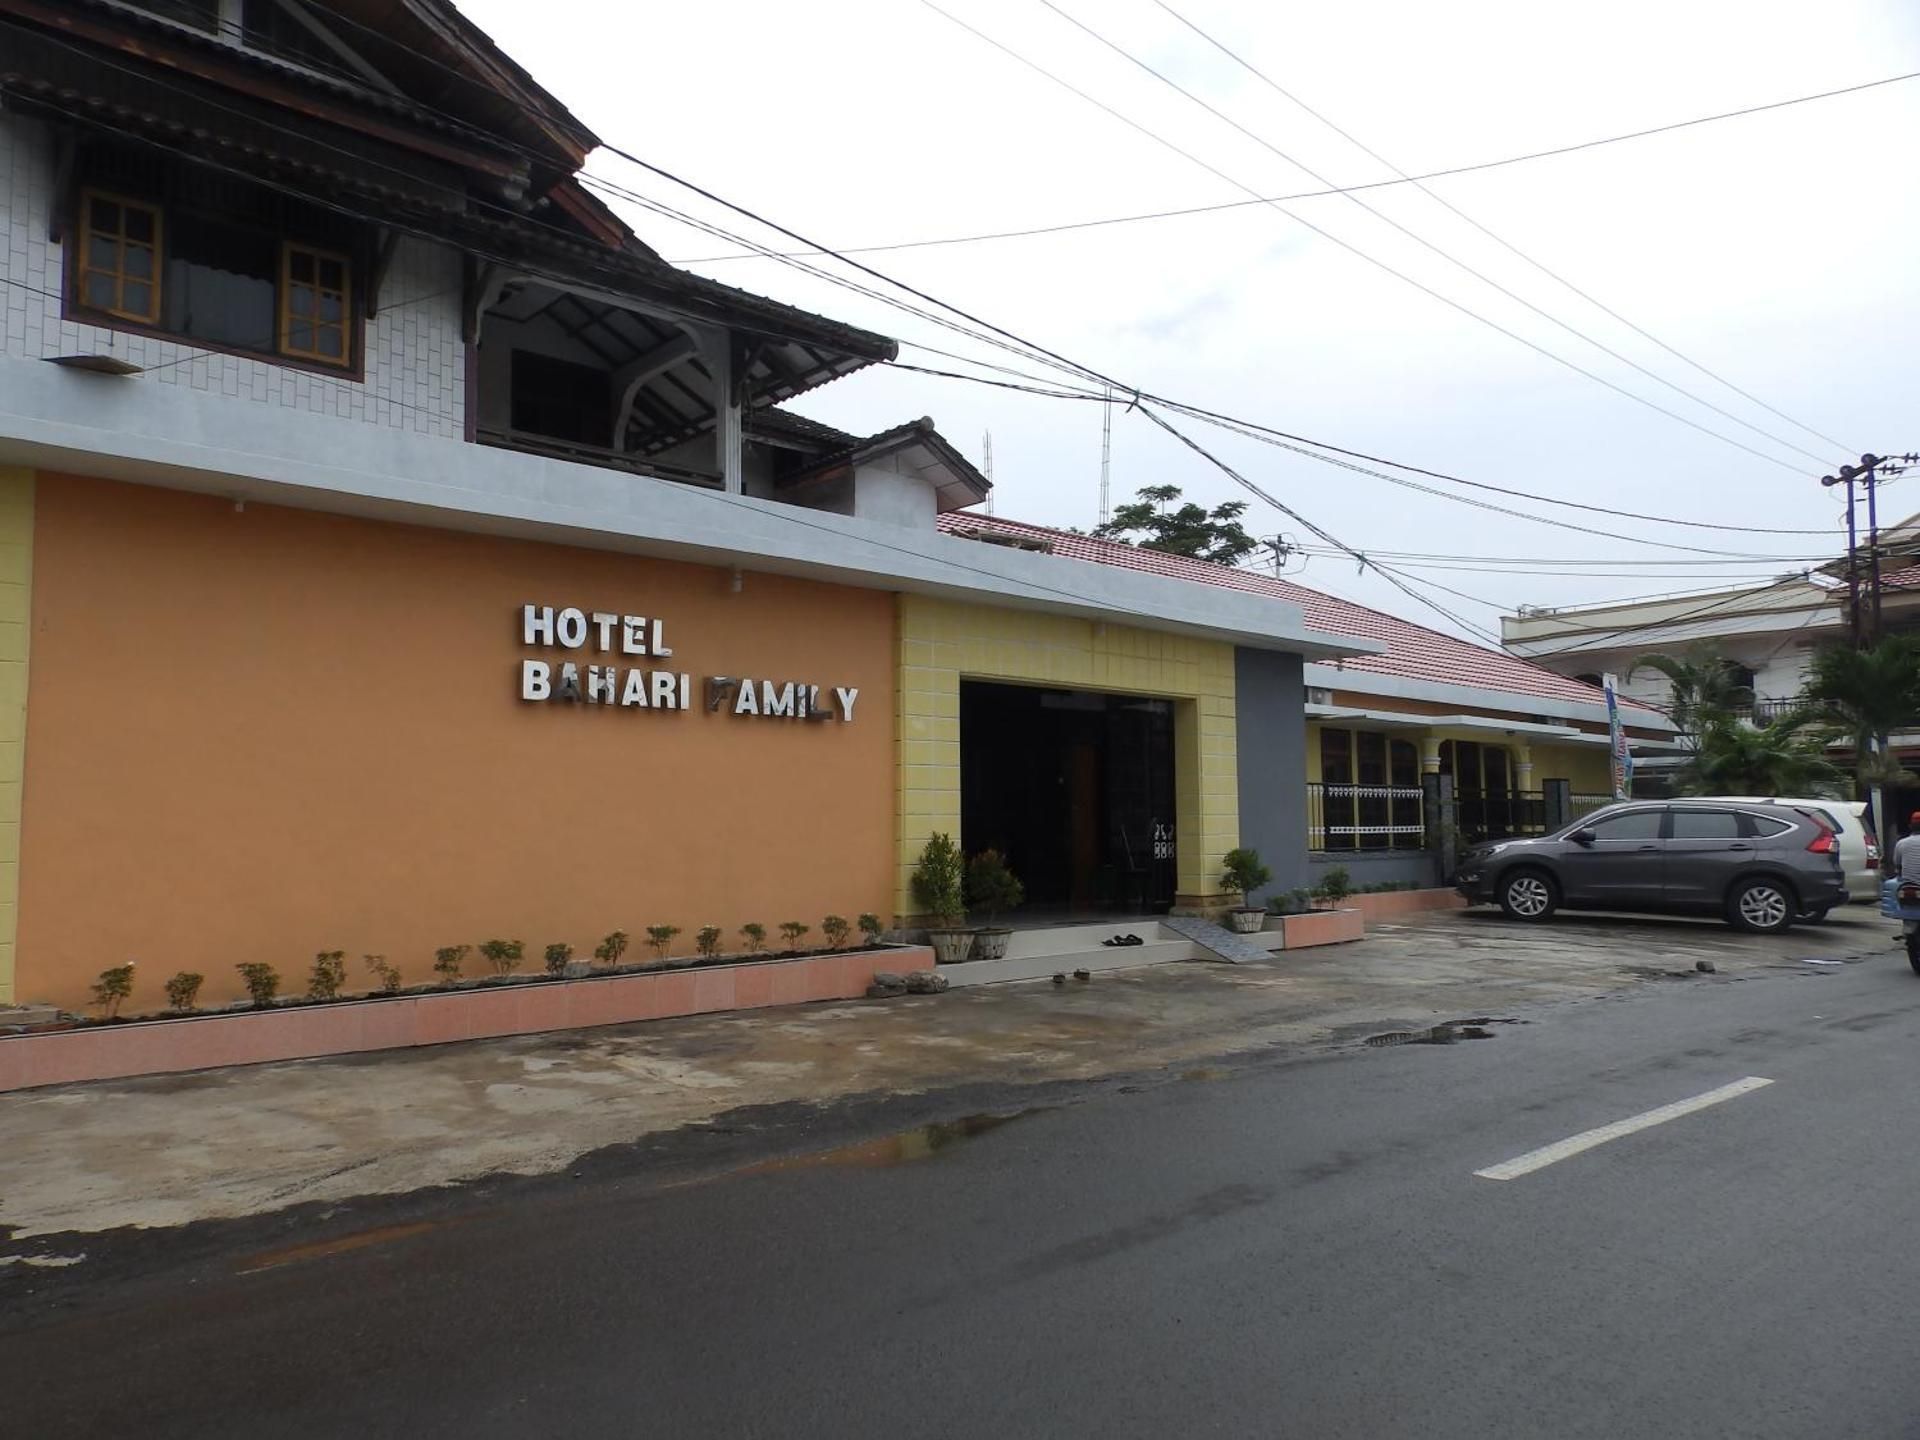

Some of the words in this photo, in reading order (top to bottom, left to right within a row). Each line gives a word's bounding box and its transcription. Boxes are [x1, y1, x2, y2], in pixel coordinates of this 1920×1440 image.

[522, 604, 673, 657] HOTEL
[522, 659, 690, 711] BAHARI
[706, 675, 858, 722] FAMILY
